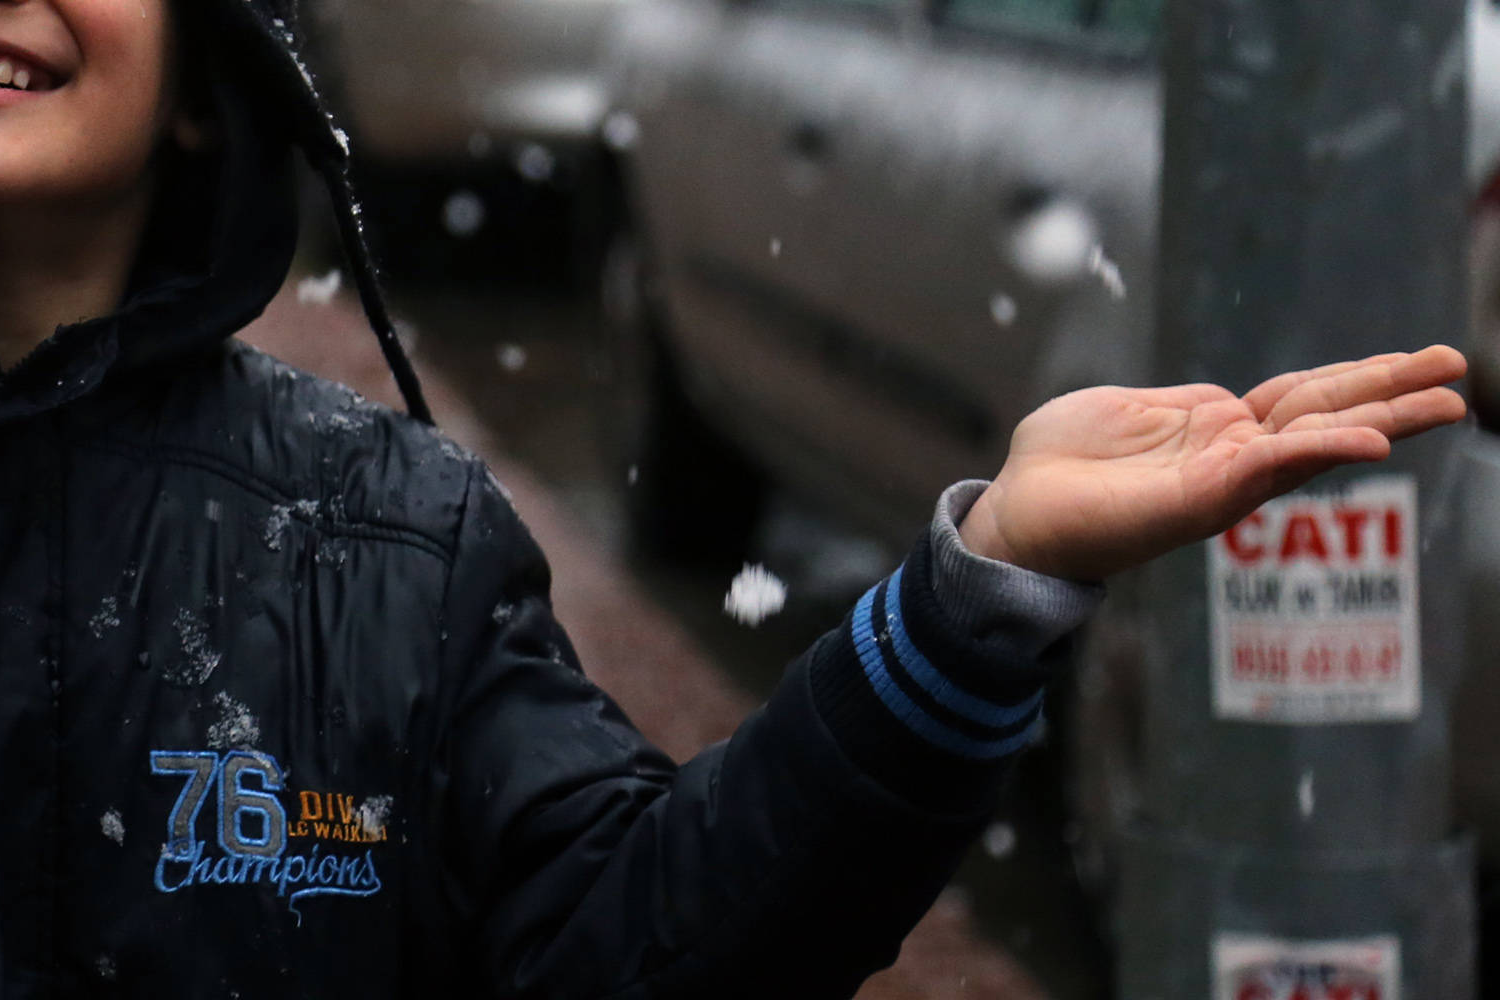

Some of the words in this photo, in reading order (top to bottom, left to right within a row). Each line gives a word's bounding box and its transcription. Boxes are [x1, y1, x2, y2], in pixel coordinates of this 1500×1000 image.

[150, 750, 288, 859] 76
[288, 821, 308, 837] LC
[314, 822, 388, 842] WAIKI
[155, 840, 382, 904] Champions
